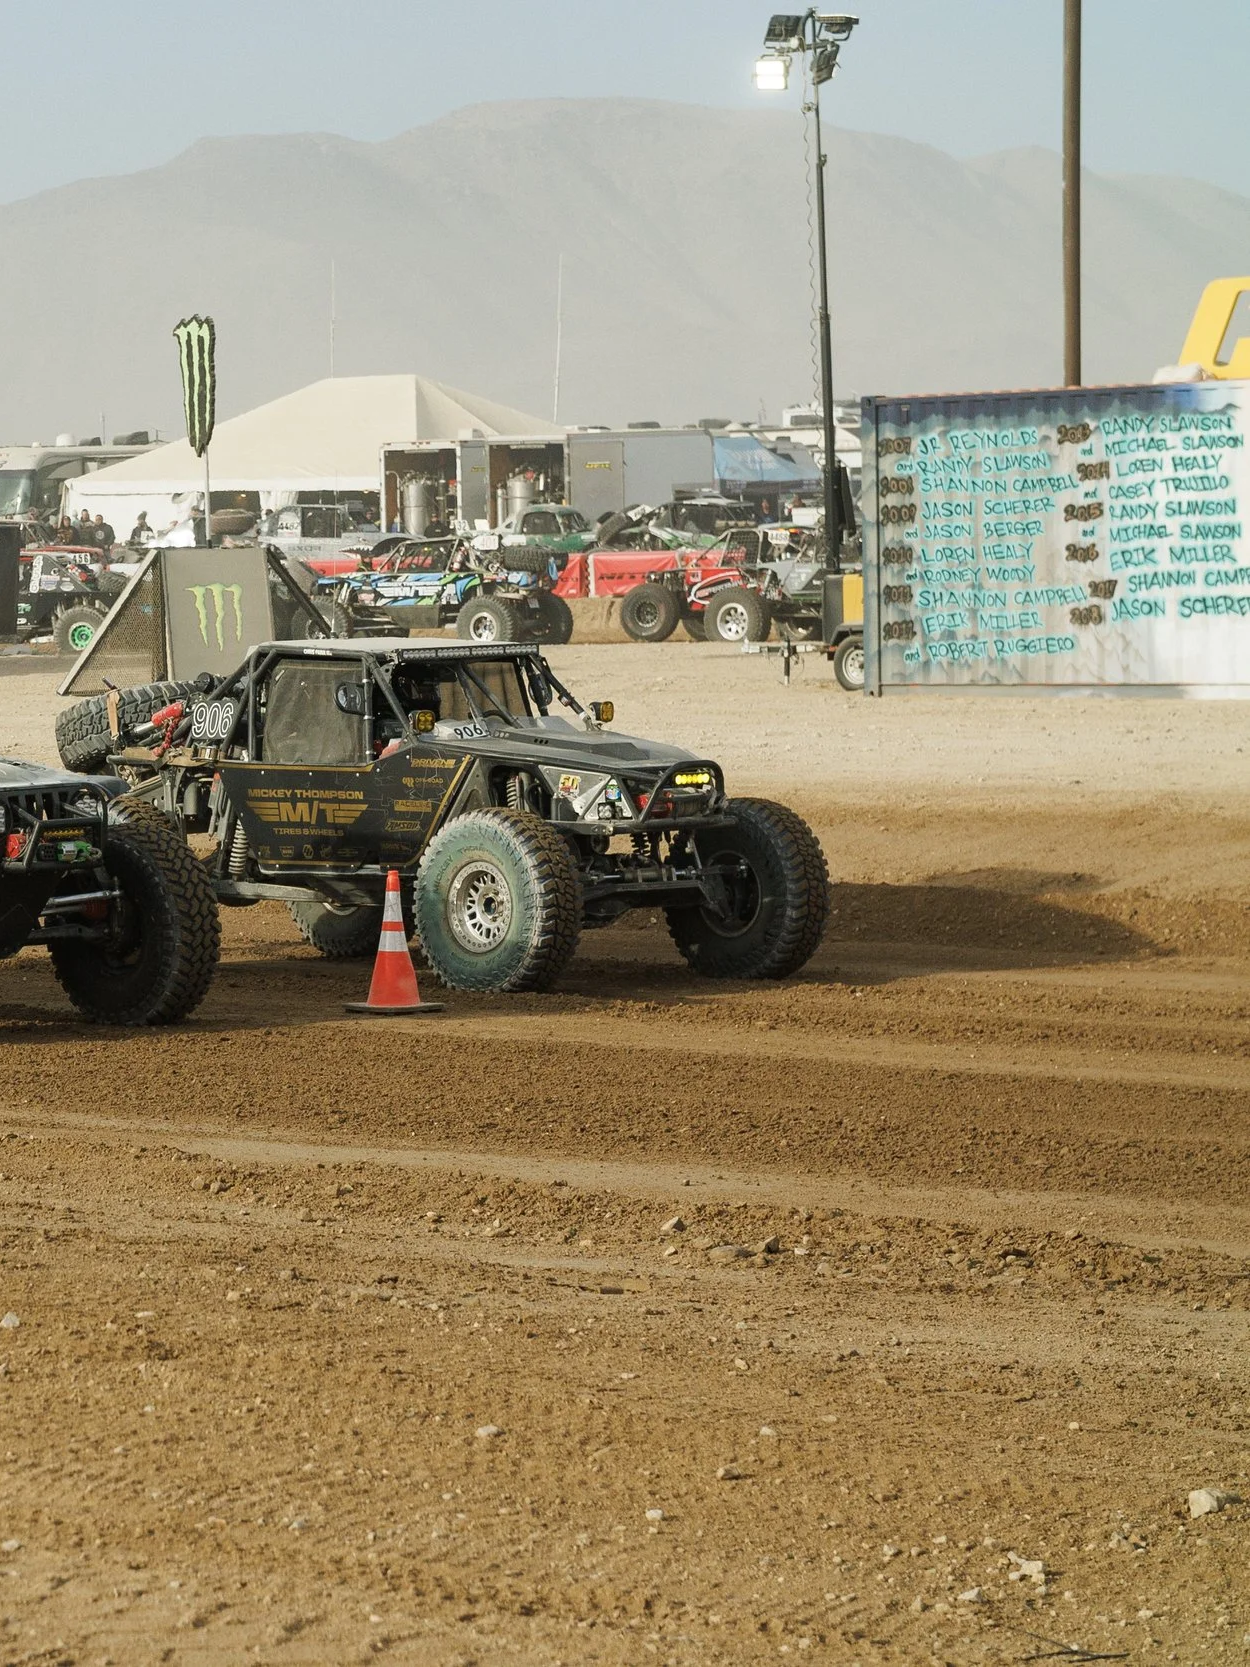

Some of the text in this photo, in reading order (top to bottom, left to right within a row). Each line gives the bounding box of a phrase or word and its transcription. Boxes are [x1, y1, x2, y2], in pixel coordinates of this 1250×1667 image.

[1103, 417, 1153, 436] RANDY
[1160, 415, 1232, 433] SLAWSON
[920, 437, 941, 455] JR
[950, 430, 1038, 452] REYNOLDS
[1105, 438, 1176, 456] MICHAEL
[1183, 434, 1243, 450] SLAWSON
[917, 456, 972, 475] RANDY
[983, 451, 1048, 473] SLAWSON
[1117, 458, 1163, 476] LOREN
[1172, 454, 1222, 472] HEALY
[921, 477, 1007, 494] SHANNON
[1013, 474, 1079, 494] CAMPBELL
[1109, 480, 1155, 499] CASEY
[922, 502, 973, 519] JASON
[984, 497, 1055, 515] SCHERER
[1109, 503, 1158, 521] RANDY
[1165, 500, 1237, 516] SLAWSON
[923, 525, 971, 539] JASON
[984, 520, 1044, 538] BERGER
[1109, 526, 1173, 543] MICHAEL
[920, 547, 975, 563] LOREN
[983, 543, 1034, 560] HEALY
[1110, 548, 1157, 571] ERIK
[1170, 545, 1237, 564] MILLER
[924, 568, 981, 583] RODNEY
[987, 565, 1036, 581] WOODY
[1128, 570, 1196, 592] SHANNON
[918, 591, 1007, 607] SHANNON
[1014, 587, 1087, 605] CAMPBELL
[1112, 599, 1165, 622] JASON
[925, 612, 969, 633] ERIK
[979, 612, 1043, 630] MILLER
[929, 641, 988, 660] ROBERT
[994, 637, 1075, 656] RUGGIERO
[191, 702, 235, 739] 906
[454, 724, 483, 739] 906
[248, 789, 363, 800] MICKEY THOMPSON
[279, 801, 341, 825] M/T
[273, 827, 302, 836] TIRES
[309, 828, 344, 837] WHEELS
